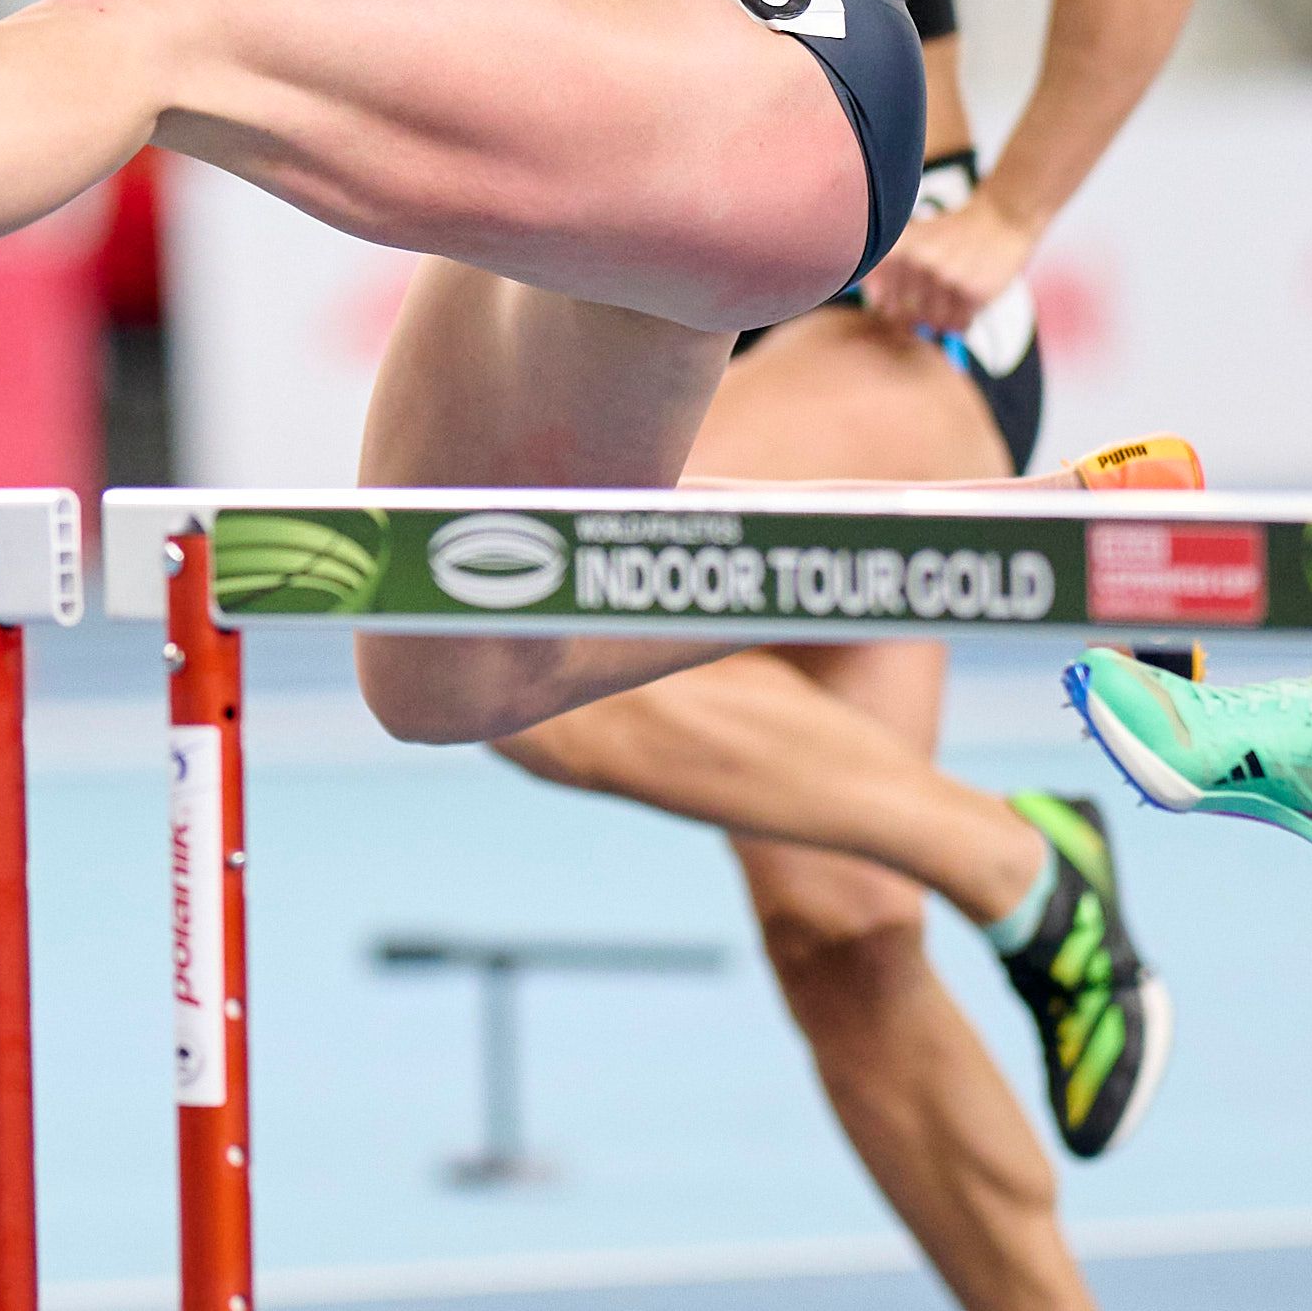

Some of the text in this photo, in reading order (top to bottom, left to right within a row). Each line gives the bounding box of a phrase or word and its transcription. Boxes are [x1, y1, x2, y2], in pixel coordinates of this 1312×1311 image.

[574, 544, 767, 613] INDOOR
[765, 547, 907, 617] TOUR
[905, 547, 1056, 620] GOLD
